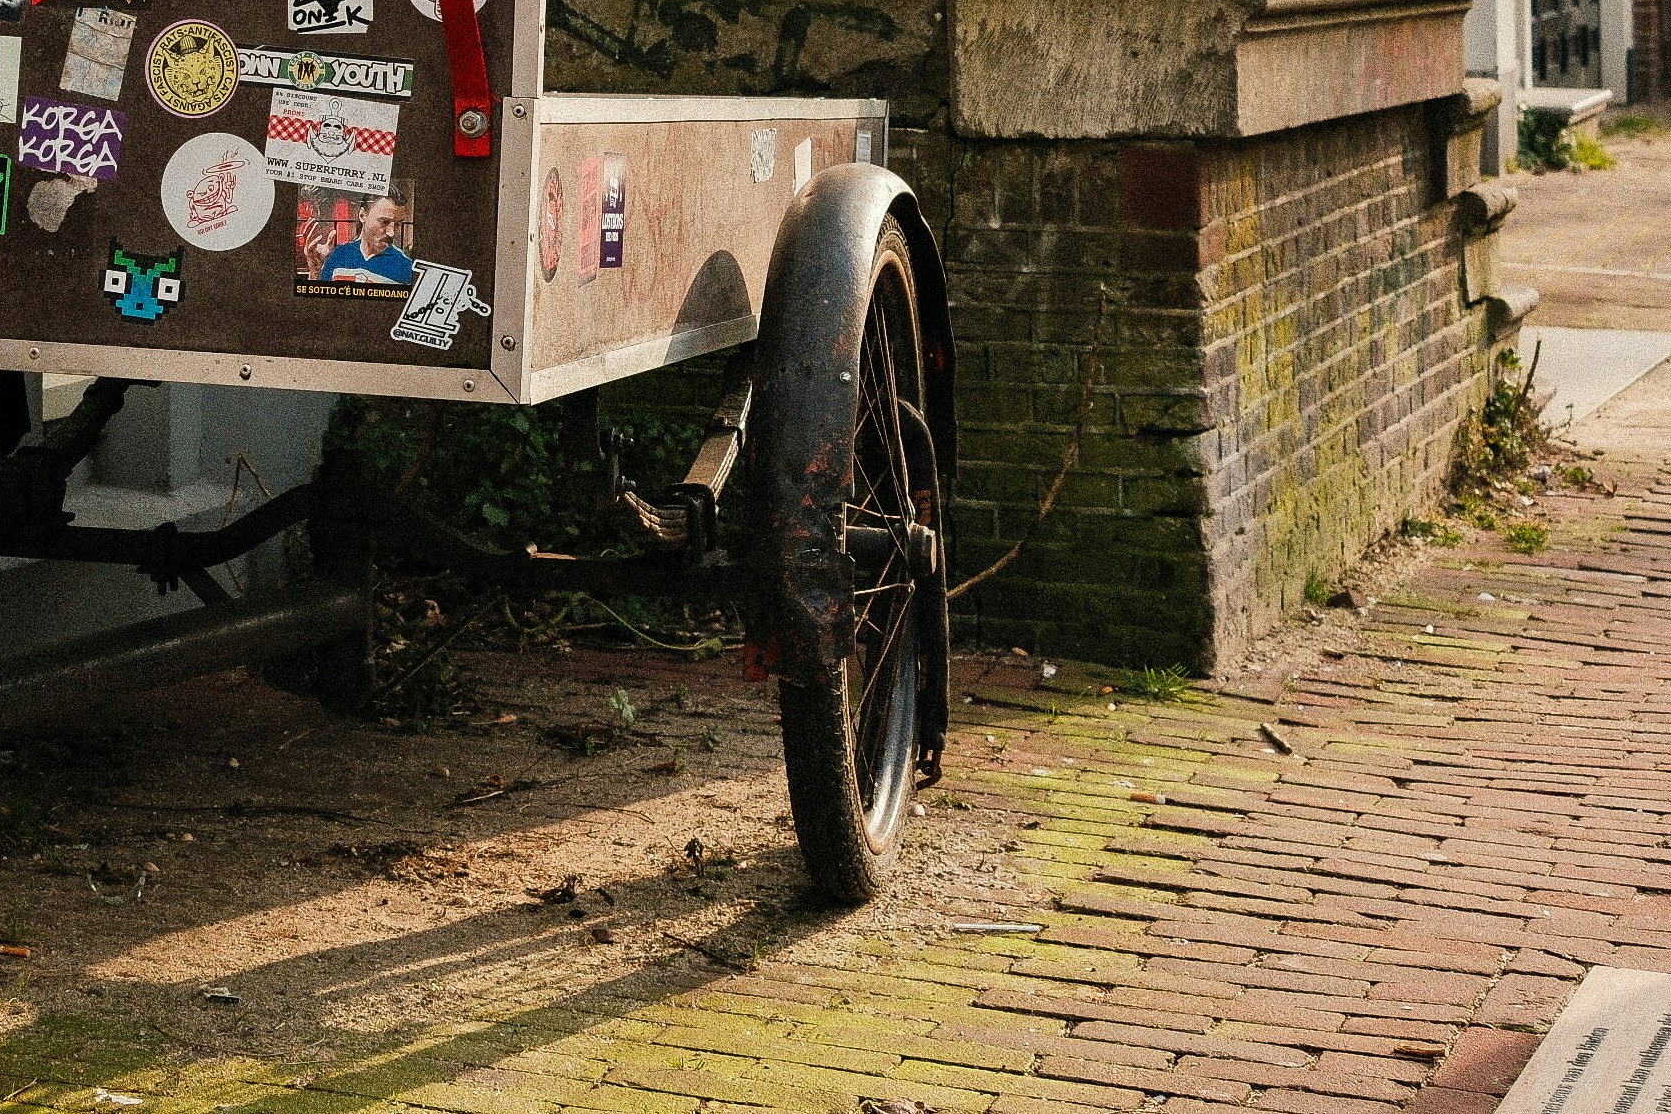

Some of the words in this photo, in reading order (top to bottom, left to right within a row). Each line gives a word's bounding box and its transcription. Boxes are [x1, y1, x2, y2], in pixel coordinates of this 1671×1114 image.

[159, 28, 185, 50] RATS
[188, 26, 234, 74] ANTIFASCIST
[152, 50, 169, 97] FASCIST
[331, 59, 407, 94] YOUTH
[214, 76, 233, 103] CATS
[166, 95, 213, 112] AGAINST
[21, 103, 123, 145] KORGA
[18, 136, 118, 177] KORGA
[265, 168, 283, 177] YOUR
[299, 173, 317, 181] STOP
[320, 176, 343, 185] BEARD
[346, 180, 364, 188] CARE
[368, 183, 386, 191] SHOP
[266, 157, 387, 183] WWW.SUPERFURRY.NL
[296, 285, 307, 294] SE
[308, 285, 337, 295] SOTTO
[352, 288, 366, 297] UN
[367, 288, 409, 299] GENOANO
[392, 328, 450, 348] @NAT.GUILTY
